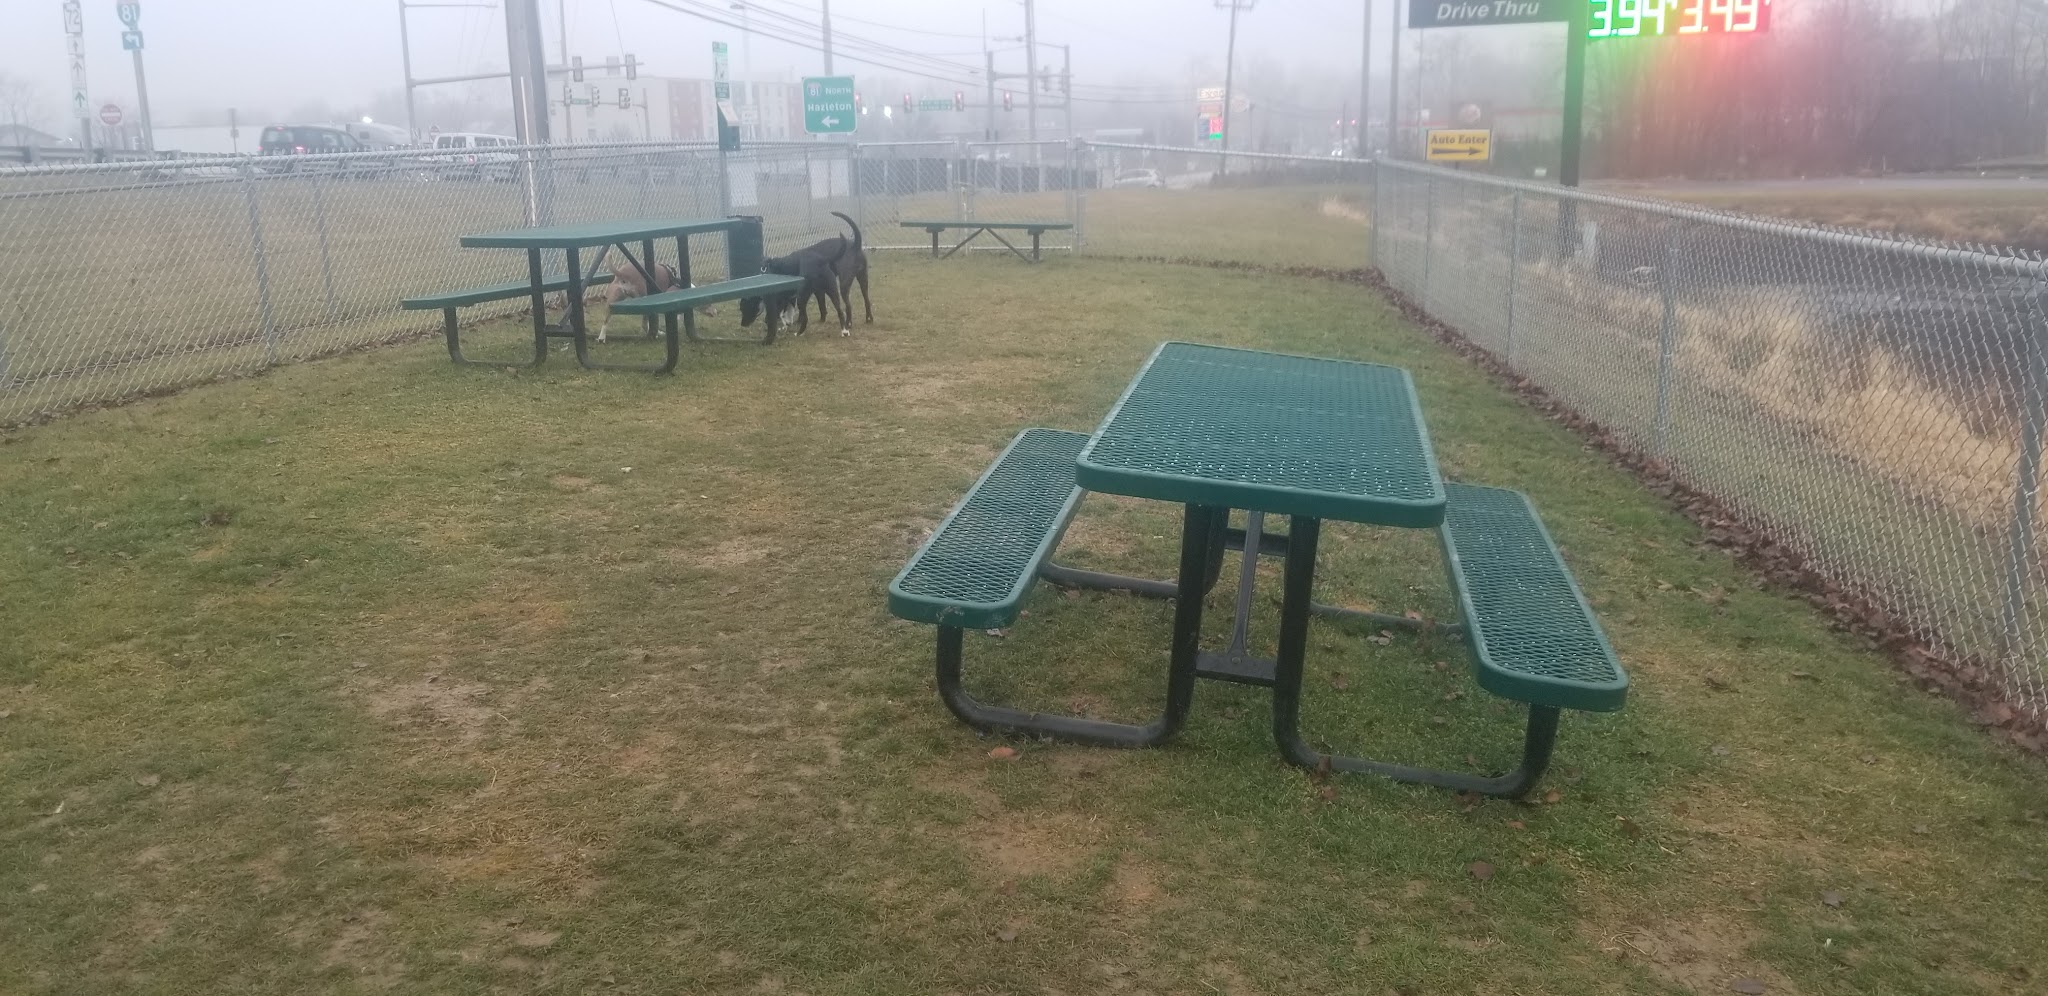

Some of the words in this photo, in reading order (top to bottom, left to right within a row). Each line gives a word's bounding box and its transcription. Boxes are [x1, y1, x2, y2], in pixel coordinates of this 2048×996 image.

[66, 9, 81, 24] 72
[121, 4, 137, 22] 81
[1437, 1, 1490, 20] Drive
[1494, 0, 1540, 17] Thru
[1679, 0, 1770, 33] 3.49
[825, 87, 852, 95] NORTH
[807, 102, 852, 112] Hazleton
[1430, 135, 1456, 145] Auto
[1458, 134, 1488, 145] Enter
